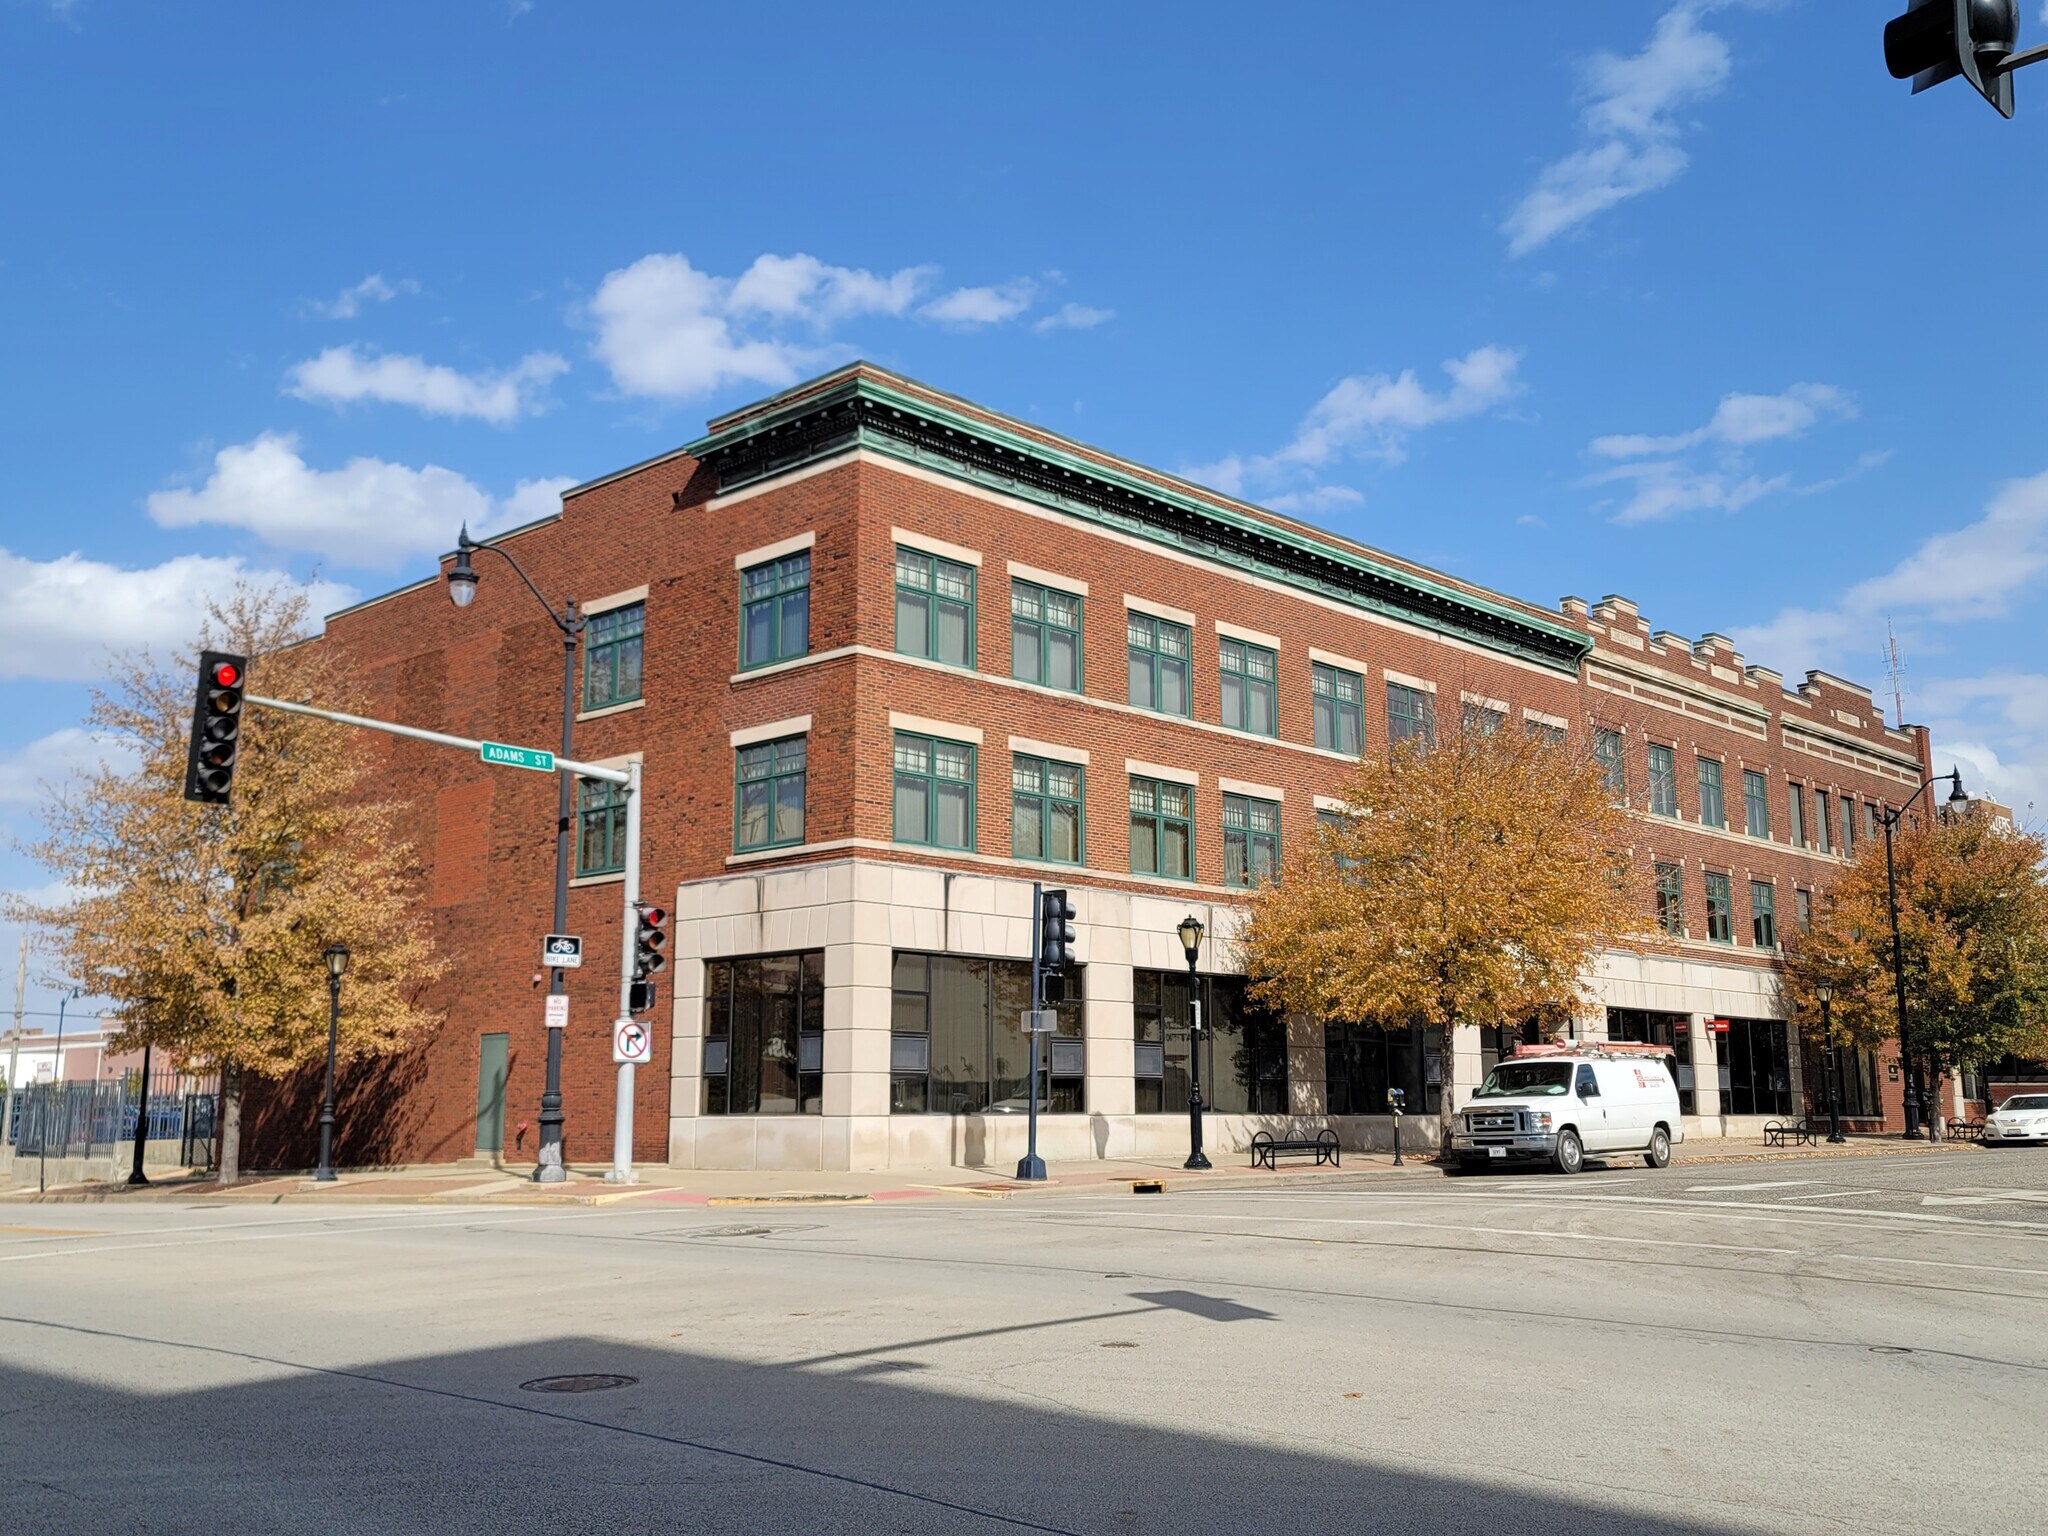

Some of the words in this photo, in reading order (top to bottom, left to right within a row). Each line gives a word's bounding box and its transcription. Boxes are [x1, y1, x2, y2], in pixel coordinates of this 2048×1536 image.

[489, 747, 525, 763] ADAMS
[535, 754, 547, 766] ST
[546, 955, 559, 963] BIKE
[562, 955, 578, 964] LANE
